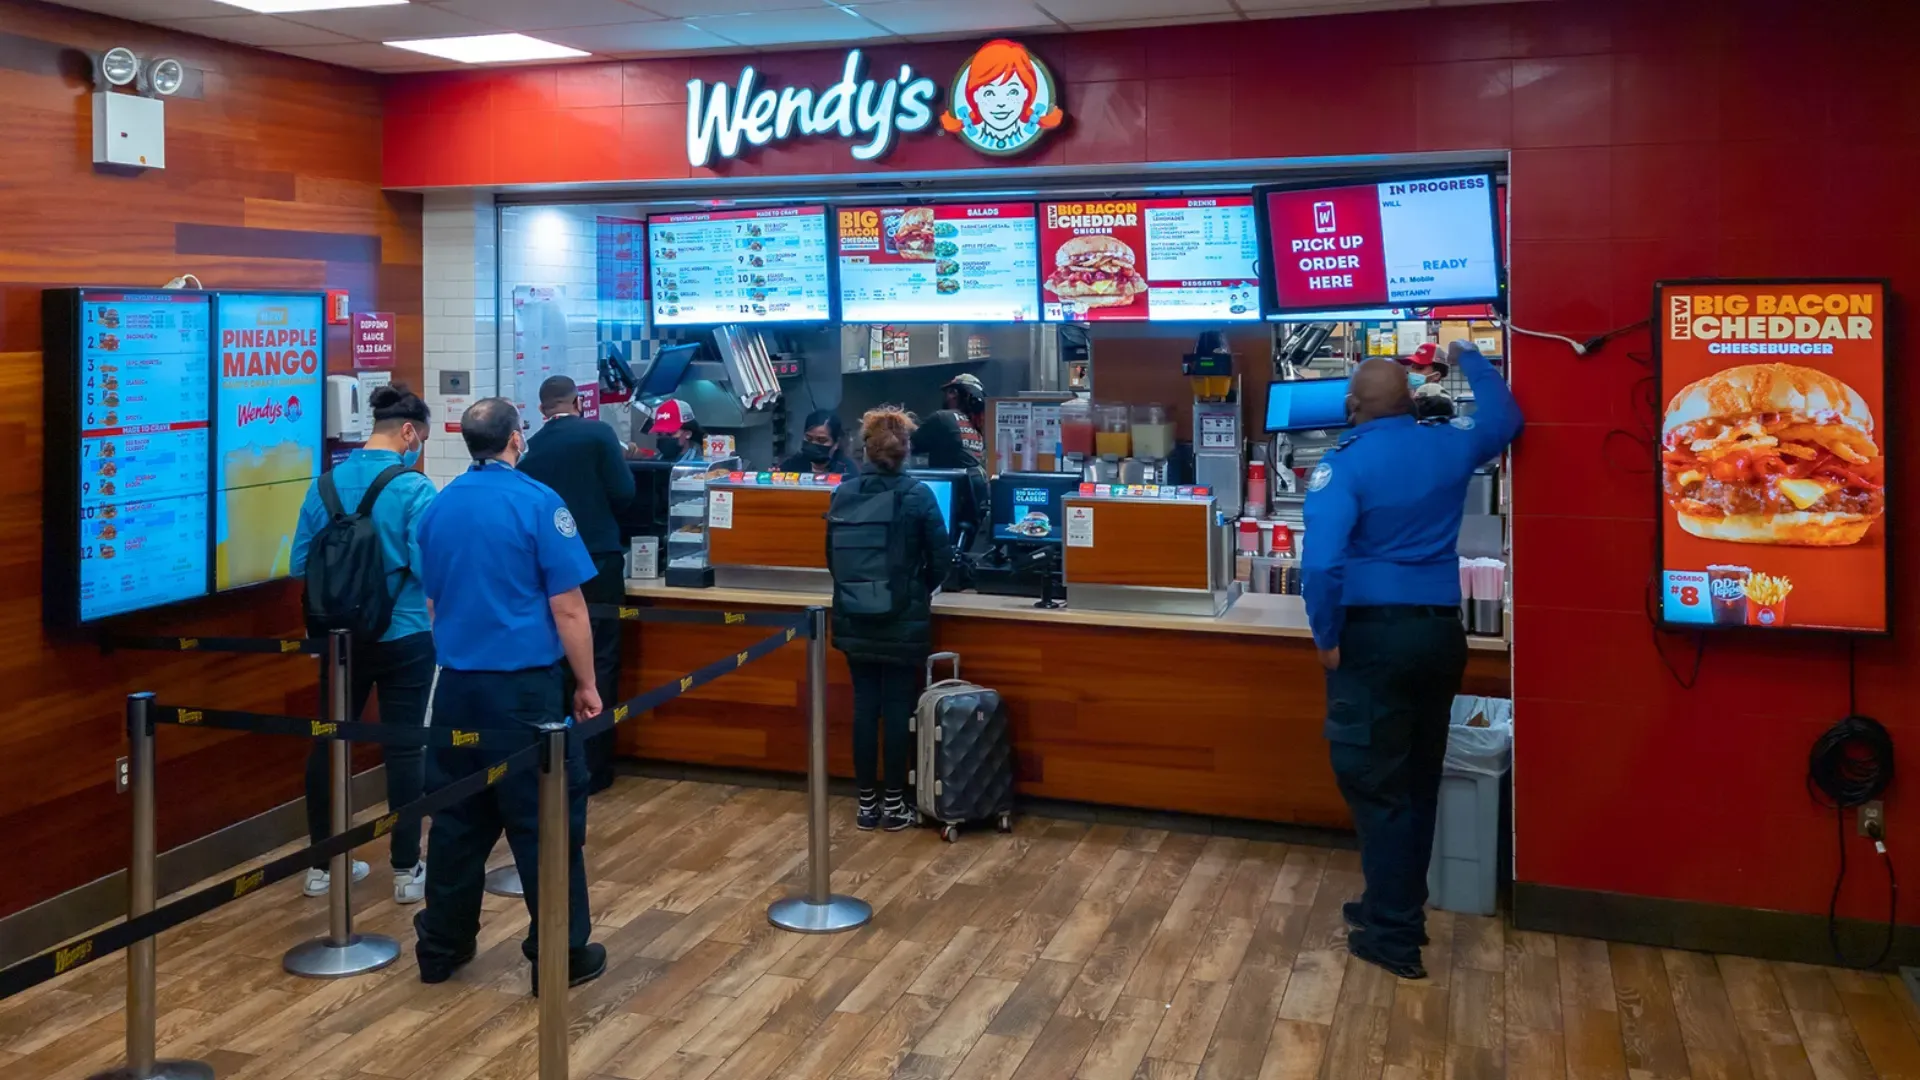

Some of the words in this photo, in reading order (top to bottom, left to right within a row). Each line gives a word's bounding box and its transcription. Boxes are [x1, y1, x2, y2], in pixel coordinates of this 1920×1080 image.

[687, 49, 936, 167] Wendy's
[1389, 185, 1405, 196] IN
[1409, 178, 1484, 194] PROGRESS
[967, 208, 998, 216] SALADS
[1058, 204, 1083, 216] BIG
[1086, 202, 1137, 214] BACON
[840, 211, 878, 228] BIG
[1058, 214, 1138, 228] CHEDDAR
[1320, 210, 1330, 224] W
[654, 233, 658, 241] 1
[840, 228, 879, 236] BACON
[840, 236, 879, 244] CHEDDAR
[1292, 237, 1336, 252] PICK
[1340, 235, 1364, 249] UP
[654, 250, 660, 258] 2
[738, 256, 744, 264] 9
[1299, 255, 1360, 271] ORDER
[1423, 258, 1468, 270] READY
[738, 274, 748, 282] 10
[1308, 274, 1353, 290] HERE
[658, 292, 662, 300] 5
[658, 306, 664, 314] 6
[740, 305, 749, 313] 12
[1694, 295, 1750, 315] BIG
[1756, 294, 1873, 315] BACON
[88, 310, 94, 322] 1
[1674, 298, 1688, 337] NEW
[360, 320, 388, 329] DIPPING
[1692, 316, 1873, 340] CHEDDAR
[88, 336, 94, 348] 2
[222, 329, 316, 348] PINEAPPLE
[362, 332, 384, 341] SAUCE
[374, 344, 392, 352] EACH
[1708, 342, 1834, 354] CHEESEBURGER
[88, 360, 94, 372] 3
[223, 349, 318, 378] MANGO
[87, 376, 94, 388] 4
[88, 393, 94, 406] 5
[88, 412, 94, 424] 6
[238, 397, 283, 427] Wendy's
[122, 426, 140, 434] MADE
[84, 445, 91, 457] 7
[82, 482, 90, 495] 9
[80, 507, 94, 520] 10
[80, 546, 92, 560] 12
[1669, 574, 1704, 582] COMBO
[1724, 578, 1738, 587] Dr
[1712, 580, 1742, 598] Peppe
[1670, 585, 1700, 606] #8
